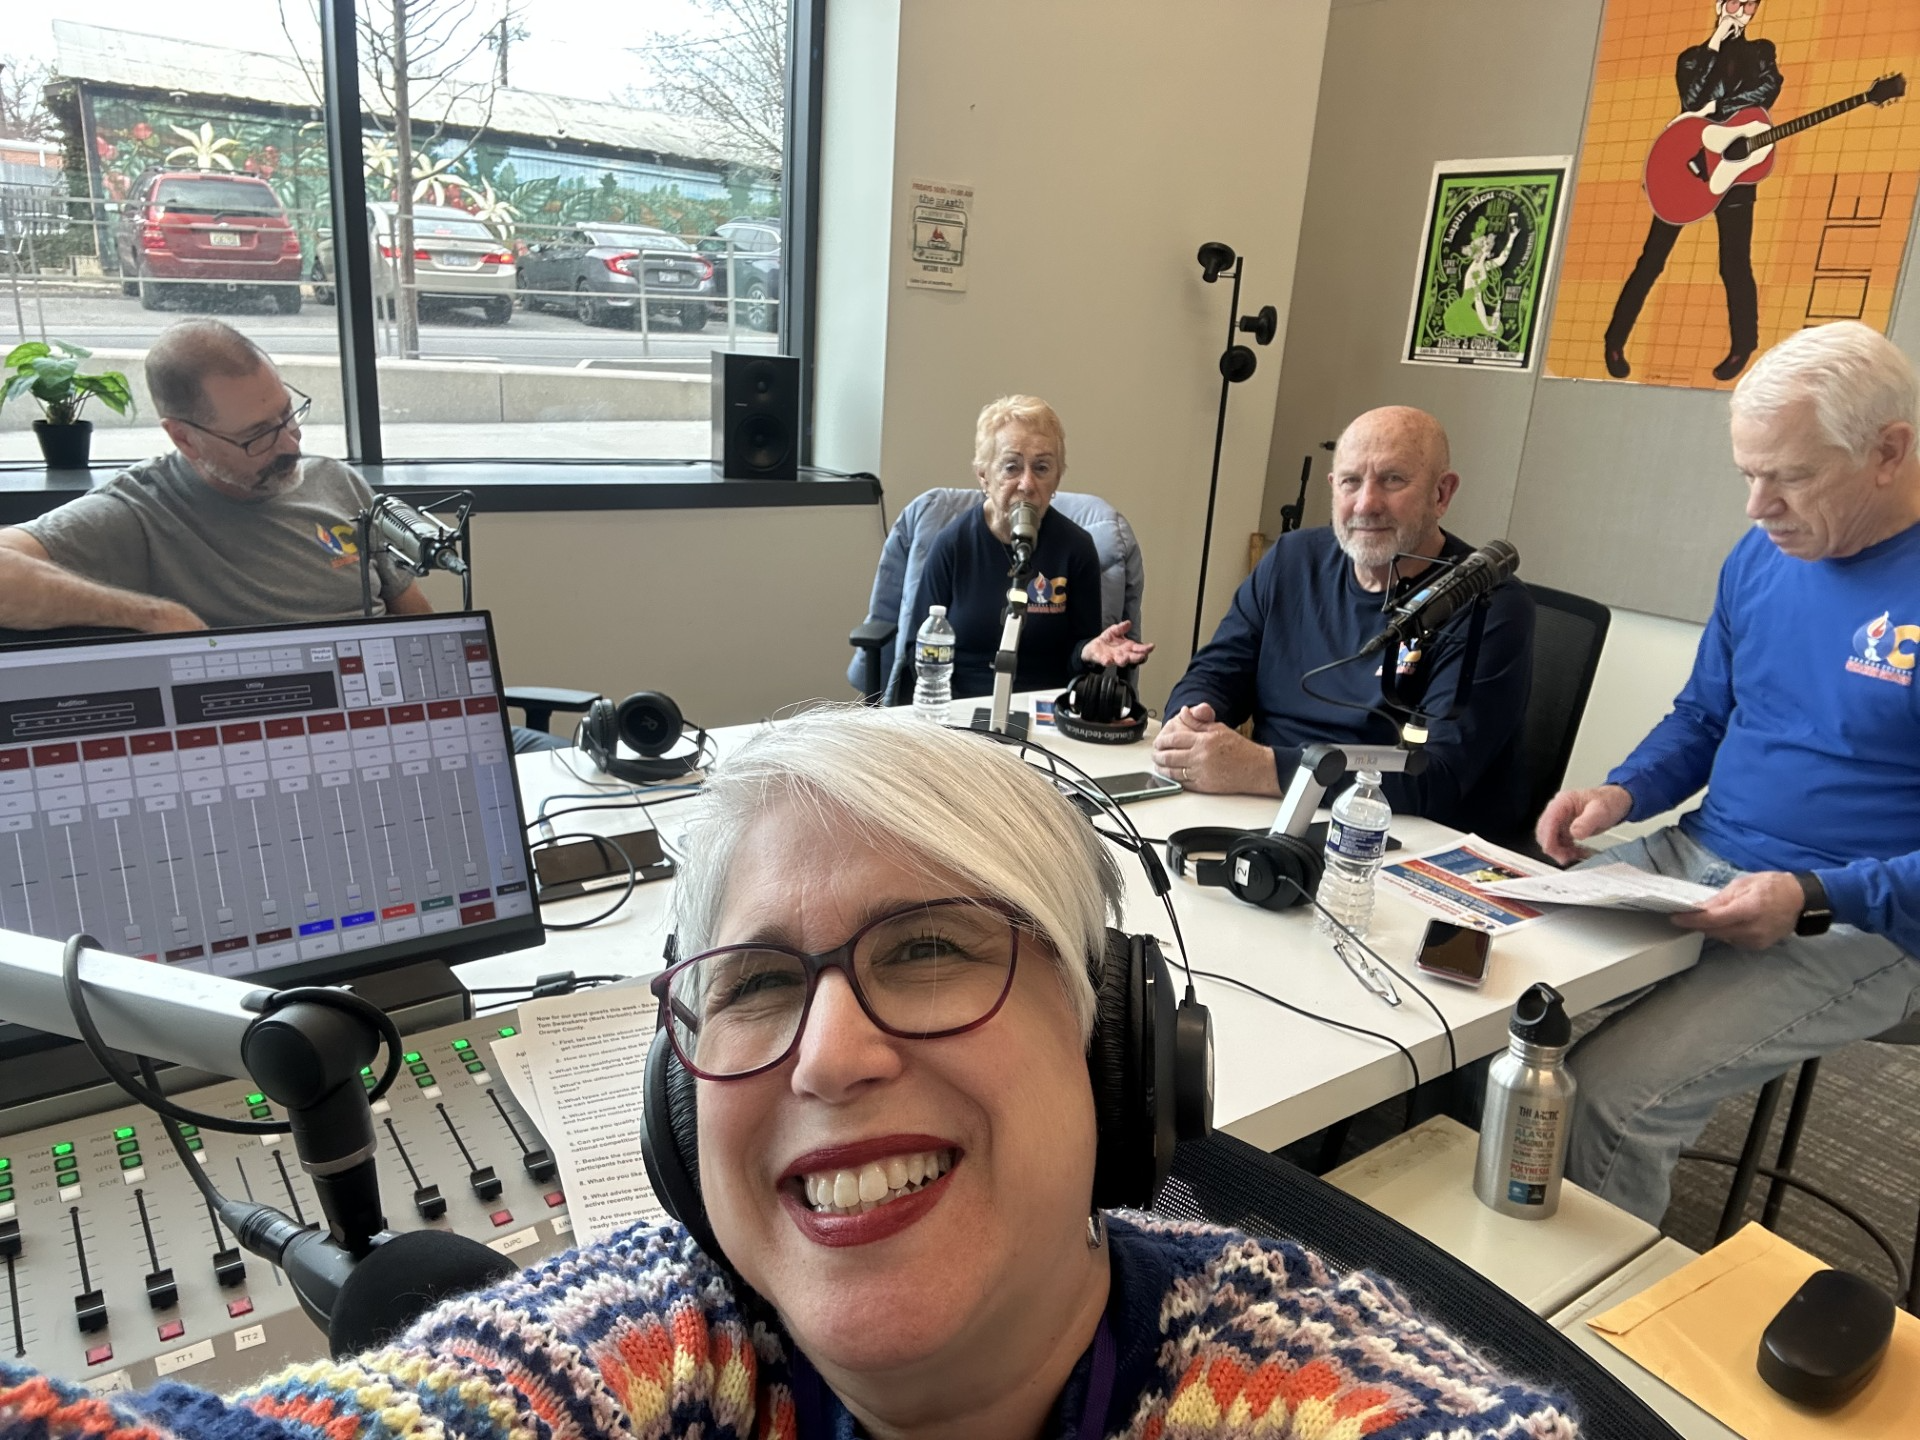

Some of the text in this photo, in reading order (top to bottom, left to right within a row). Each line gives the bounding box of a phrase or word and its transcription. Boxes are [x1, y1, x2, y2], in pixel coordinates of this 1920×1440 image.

[1803, 172, 1893, 329] ONE
[57, 700, 88, 708] Audition
[1237, 866, 1246, 877] 2
[440, 1057, 457, 1065] AUD
[591, 1058, 621, 1066] qualifying
[447, 1068, 462, 1077] UTL
[454, 1080, 471, 1089] CUE
[403, 1094, 418, 1103] CUE
[587, 1096, 616, 1104] someone
[614, 1118, 636, 1126] qualify
[1515, 1128, 1554, 1140] ALASKA
[90, 1134, 112, 1144] PGM
[238, 1140, 257, 1150] CUE
[571, 1144, 598, 1153] national
[28, 1150, 50, 1160] PGM
[93, 1149, 114, 1158] AUD
[582, 1156, 609, 1164] Besides
[29, 1165, 51, 1174] AUD
[96, 1164, 114, 1173] UTL
[161, 1161, 180, 1170] CUE
[576, 1162, 616, 1173] participants
[32, 1182, 50, 1190] UTL
[98, 1178, 120, 1188] CUE
[610, 1188, 632, 1196] advice
[33, 1196, 55, 1206] CUE
[584, 1200, 606, 1208] active
[606, 1196, 634, 1204] recently
[504, 1237, 522, 1249] DJPC
[241, 1332, 258, 1343] TT 2
[175, 1355, 188, 1364] TT
